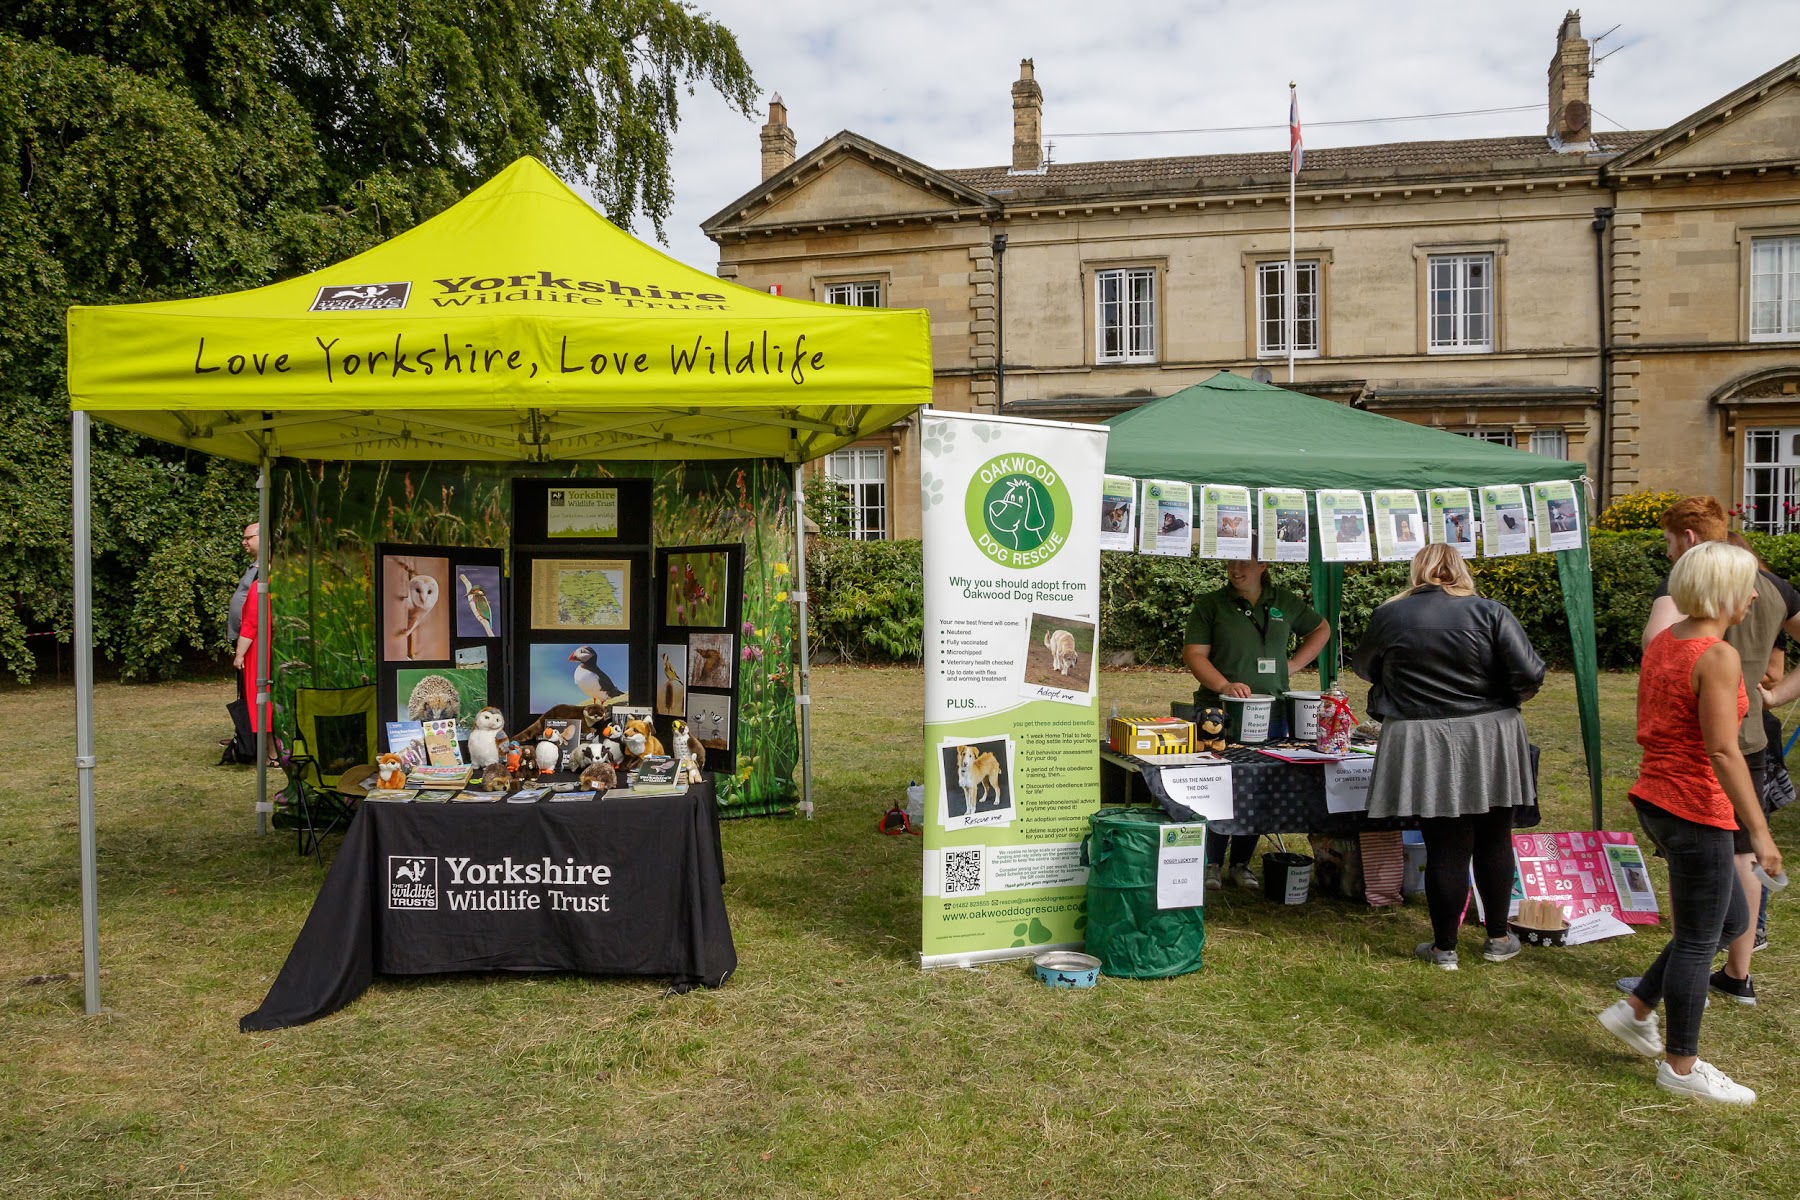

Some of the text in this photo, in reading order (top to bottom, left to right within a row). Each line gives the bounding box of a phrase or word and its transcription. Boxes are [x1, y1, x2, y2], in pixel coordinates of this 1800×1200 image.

[433, 271, 726, 302] Yorkshire
[432, 290, 731, 311] Wildlife Trust
[195, 330, 825, 385] Love Yorkshire, Love Wildlife
[980, 457, 1055, 486] OAKWOOD
[568, 491, 615, 499] Yorkshire
[978, 532, 1063, 565] DOG RESCUE
[949, 576, 1086, 591] Why you should adopt from
[963, 588, 1073, 602] Oakwood Dog Rescue
[1037, 687, 1074, 700] Adopt me
[964, 816, 990, 826] Rescue
[1588, 836, 1596, 847] 6
[445, 856, 611, 885] Yorkshire
[1546, 864, 1557, 872] 16
[392, 883, 435, 898] wildlife
[1554, 880, 1573, 890] 20
[392, 898, 435, 906] TRUSTS
[446, 890, 610, 912] Wildlife Trust
